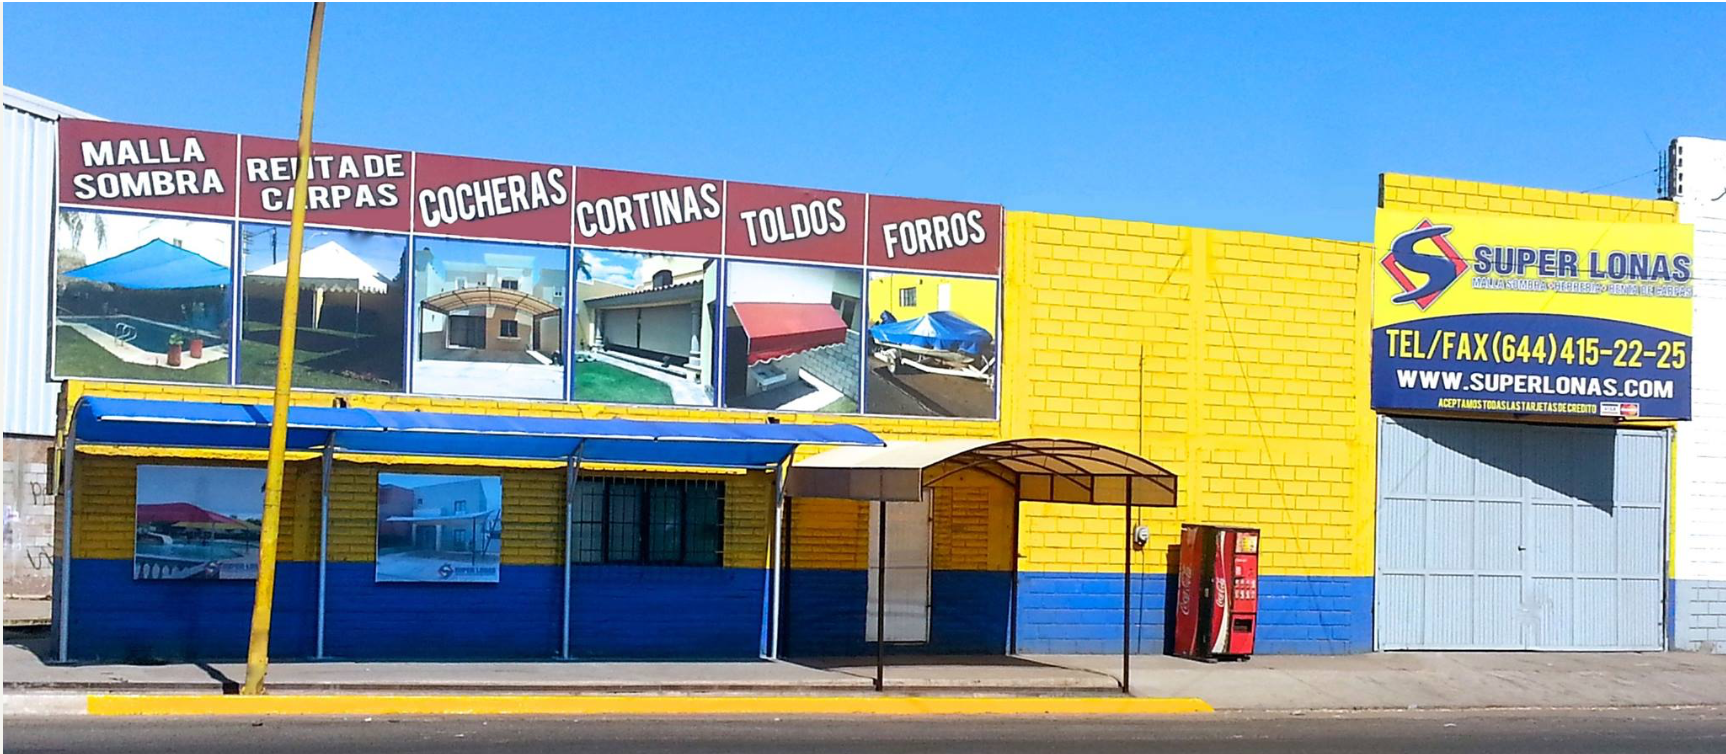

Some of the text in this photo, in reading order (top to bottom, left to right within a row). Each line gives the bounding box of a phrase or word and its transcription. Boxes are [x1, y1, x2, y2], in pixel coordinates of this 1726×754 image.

[81, 137, 206, 168] MALLA
[363, 153, 405, 178] DE
[73, 168, 225, 201] SOMBRA
[418, 167, 568, 228] COCHERAS
[576, 182, 721, 238] CORTINAS
[740, 197, 847, 247] TOLDOS
[882, 209, 986, 259] FORROS
[1473, 244, 1693, 283] SUPER LONAS
[1472, 277, 1505, 290] MALLA
[1505, 278, 1548, 292] SOMBRA
[1386, 329, 1686, 369] TEL/FAX (644) 415-22-25
[1396, 369, 1674, 399] WWW.SUPERLONAS.COM
